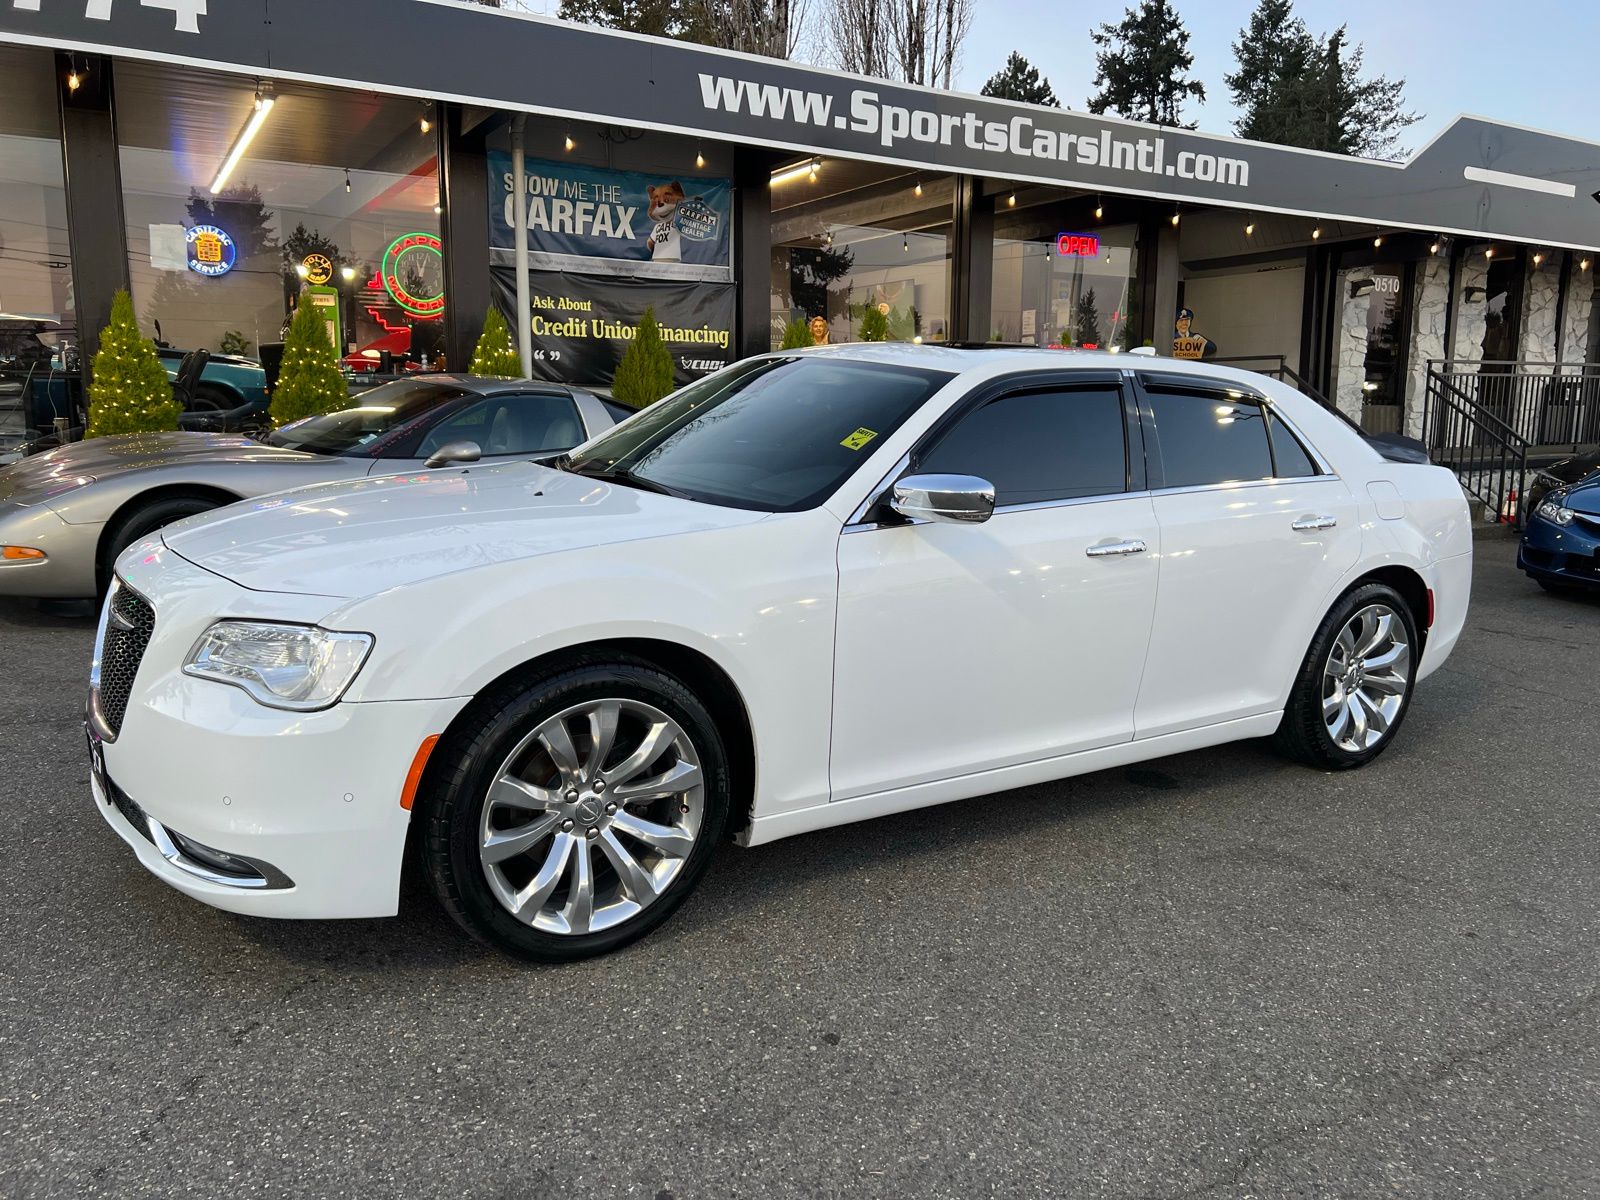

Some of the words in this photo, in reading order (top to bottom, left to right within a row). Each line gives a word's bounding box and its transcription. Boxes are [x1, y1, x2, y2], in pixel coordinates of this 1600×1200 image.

[698, 73, 1249, 187] www.SportsCarsIntl.com
[564, 180, 588, 200] ME
[592, 184, 621, 204] THE
[185, 225, 232, 246] CADILLAC
[656, 232, 670, 243] FOX
[681, 227, 704, 238] DEALER
[1059, 235, 1097, 256] OPEN
[190, 259, 229, 274] SERVICE
[1371, 277, 1400, 293] 0510
[533, 296, 555, 309] Ask
[558, 298, 592, 312] About
[531, 315, 588, 338] Credit
[656, 322, 730, 349] inancing
[1173, 341, 1203, 352] SLOW
